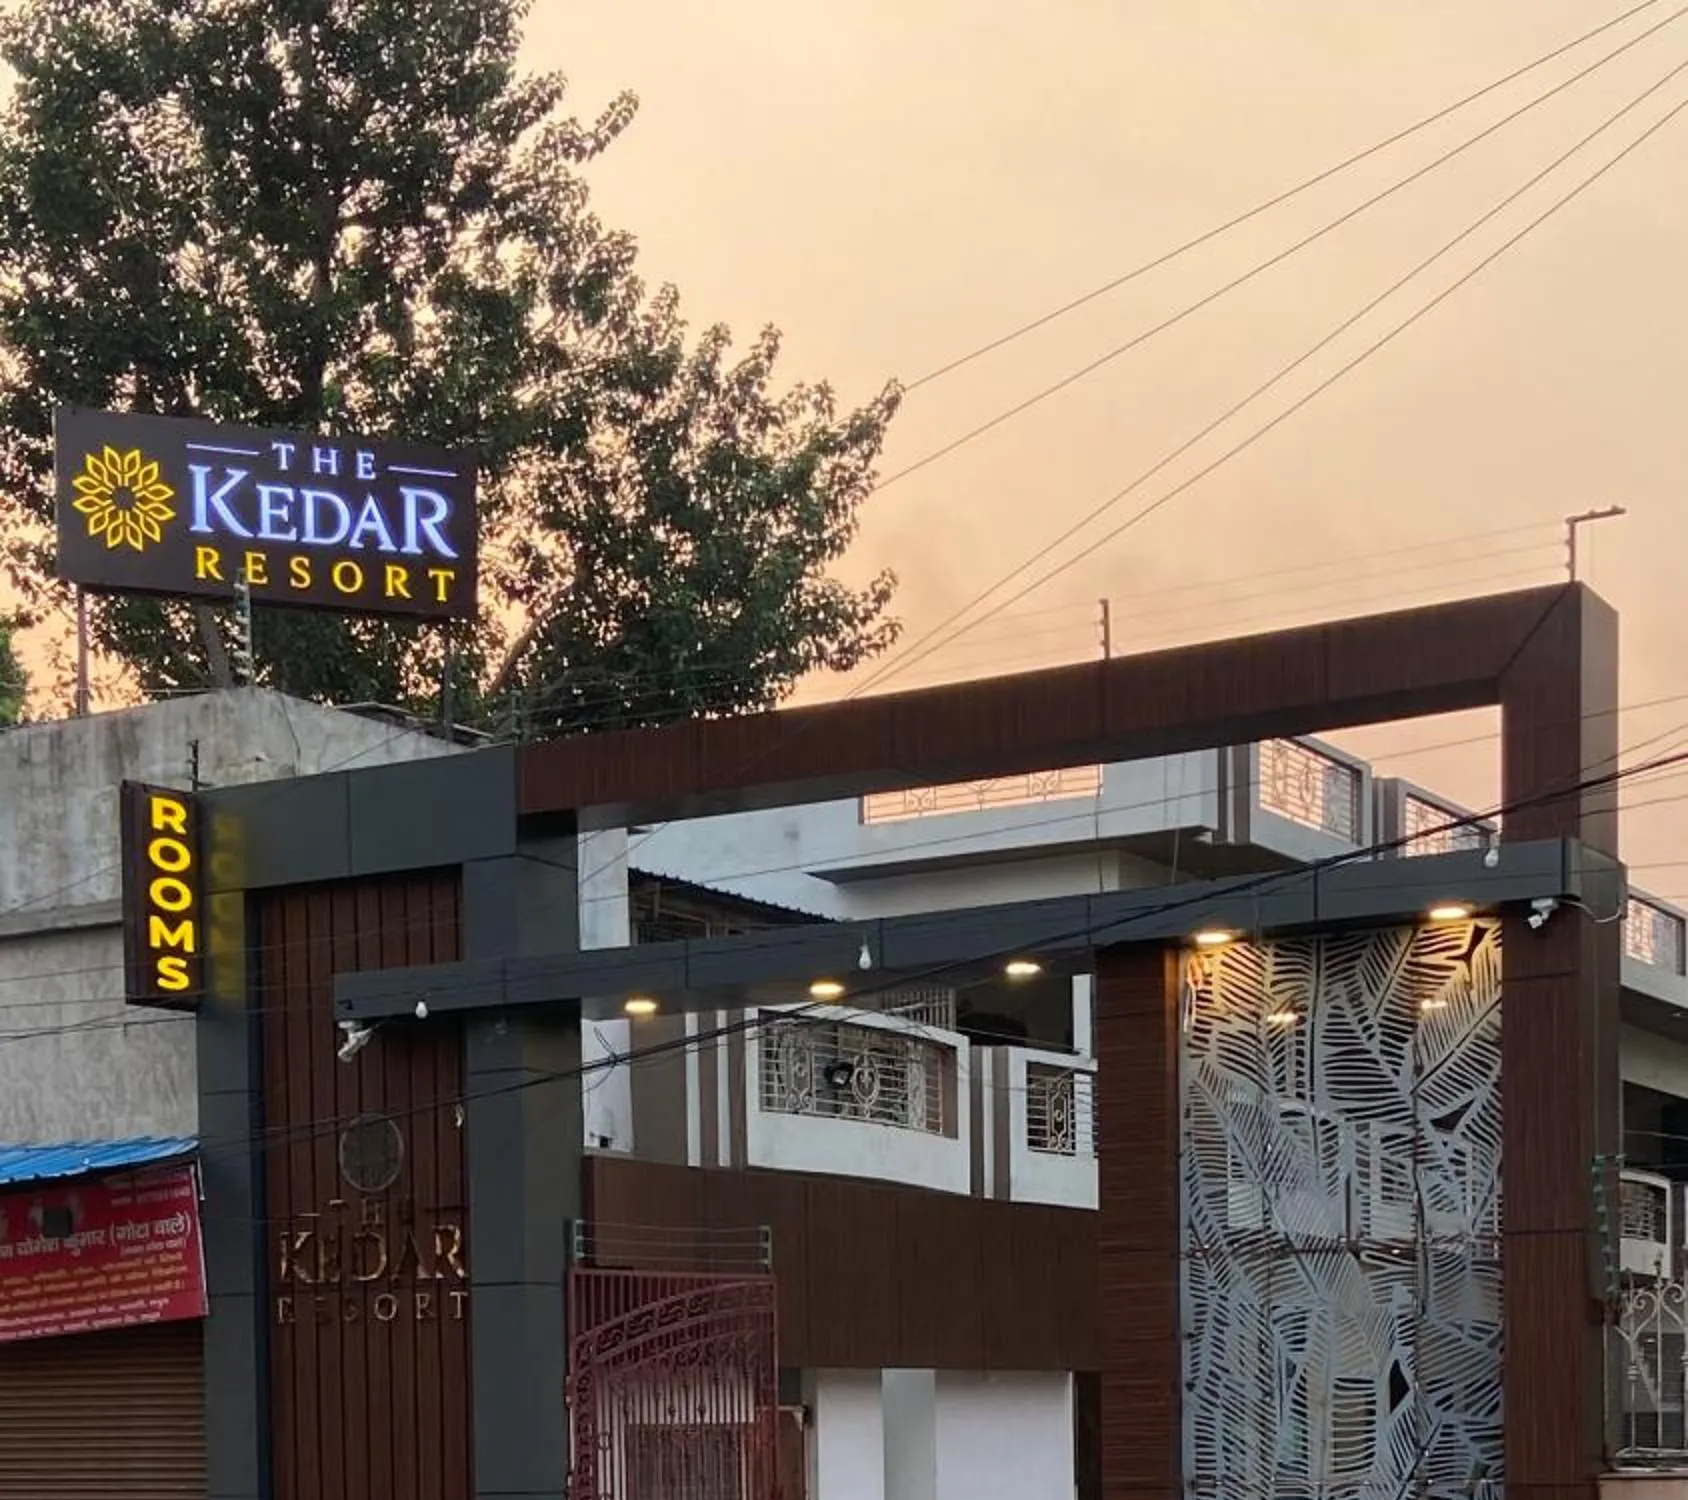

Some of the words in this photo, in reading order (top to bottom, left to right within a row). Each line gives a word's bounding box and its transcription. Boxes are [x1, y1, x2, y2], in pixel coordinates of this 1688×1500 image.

[270, 442, 377, 480] THE
[187, 463, 459, 559] KEDAR
[194, 546, 456, 602] RESORT
[148, 796, 195, 991] ROOMS
[278, 1224, 468, 1284] KEDAR
